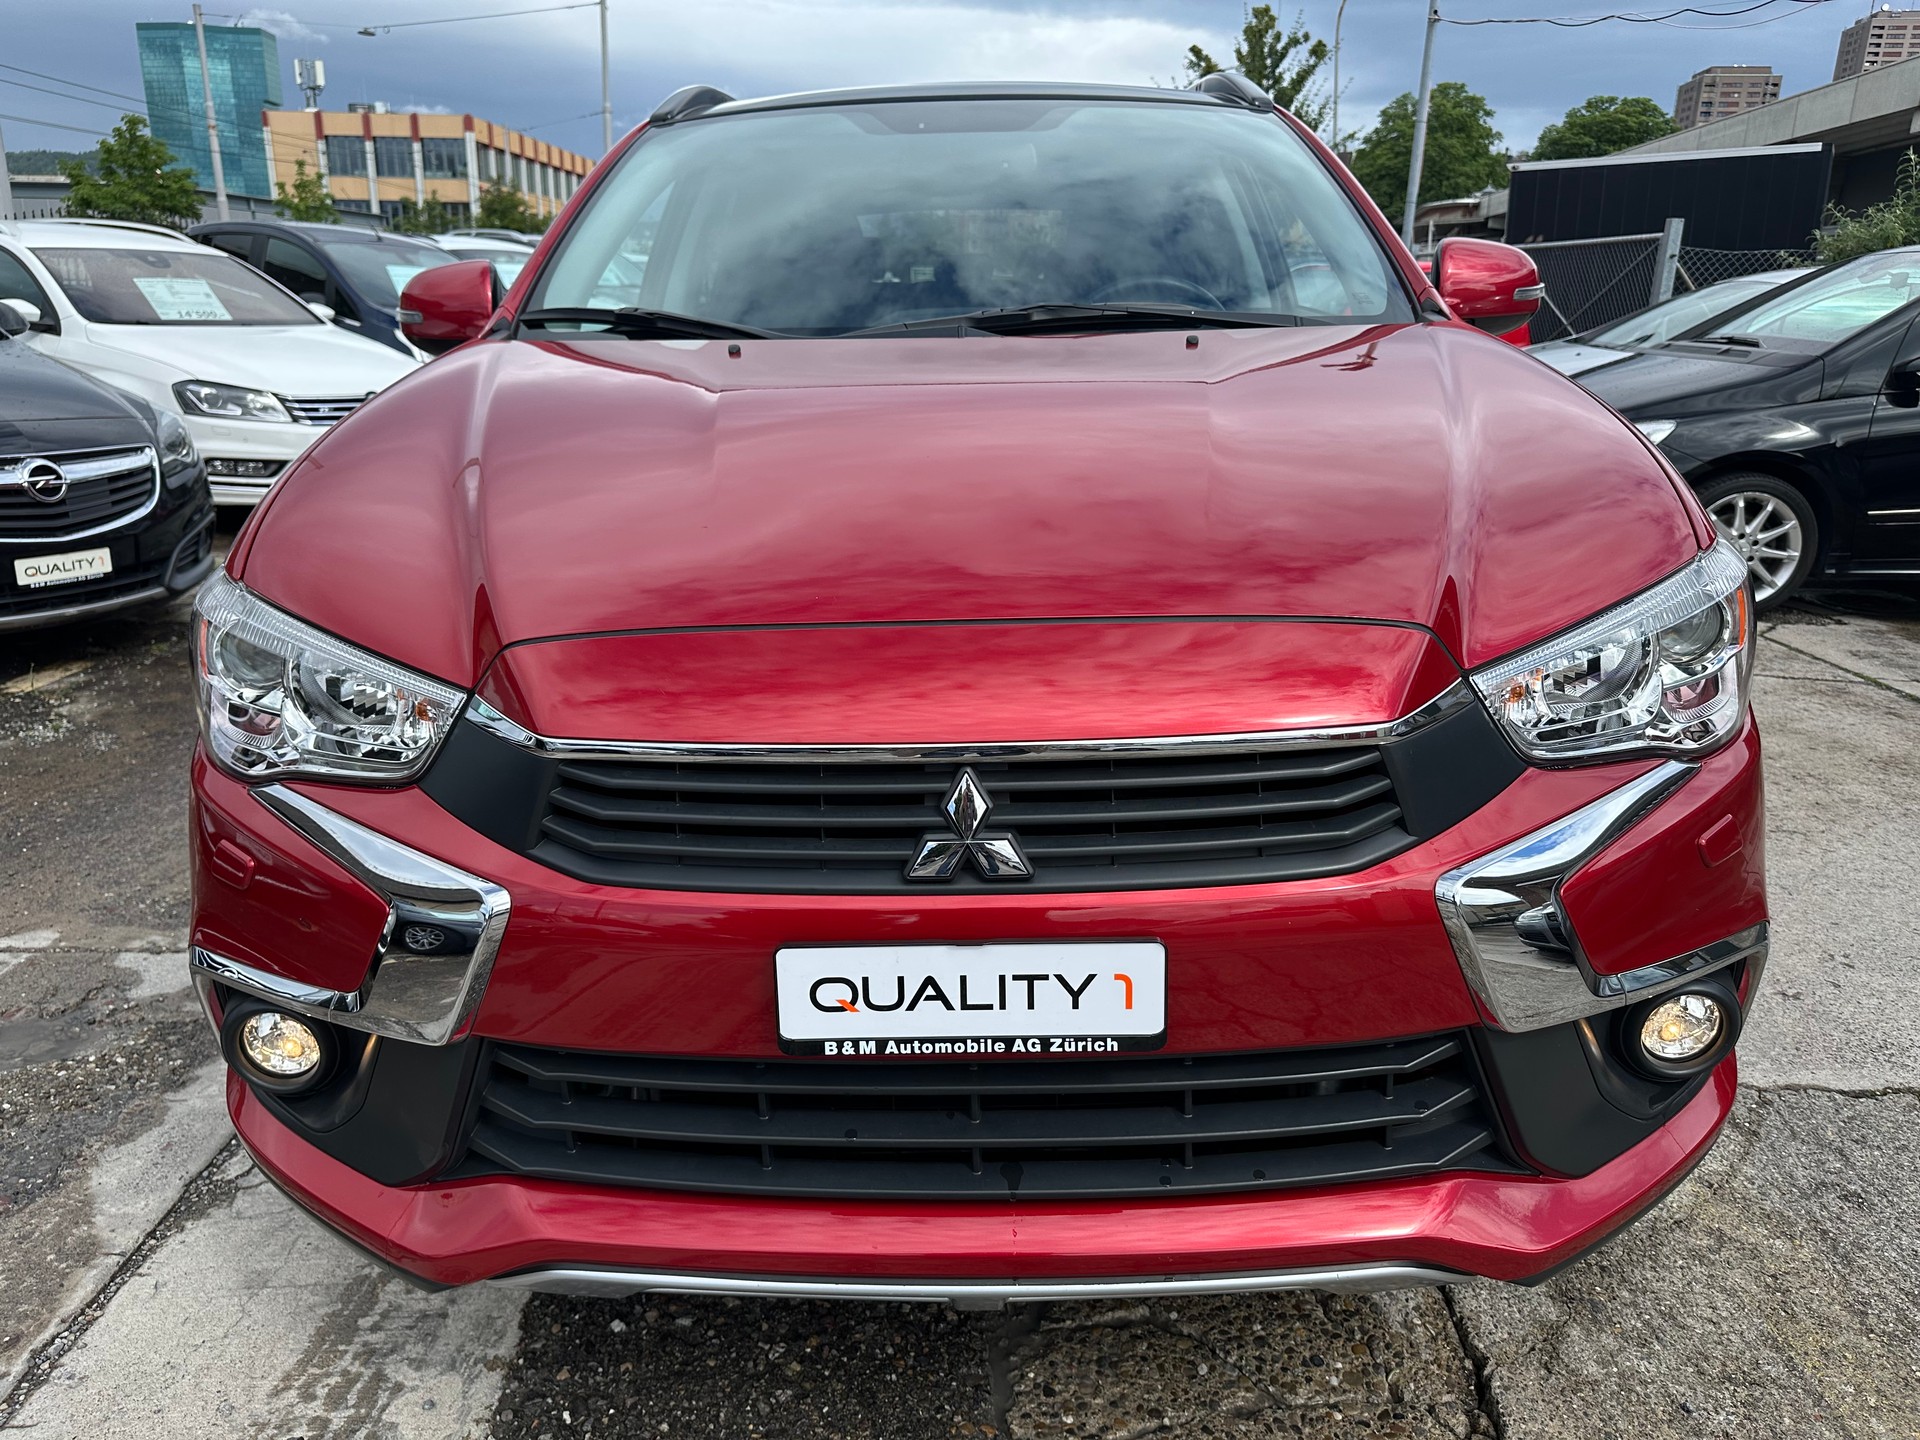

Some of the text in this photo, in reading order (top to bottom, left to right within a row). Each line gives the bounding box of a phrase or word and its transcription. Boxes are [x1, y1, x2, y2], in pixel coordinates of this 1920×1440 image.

[25, 557, 95, 577] QUALITY
[809, 973, 1133, 1013] QUALITY 1
[884, 1039, 1005, 1054] Automobile
[1012, 1038, 1041, 1053] AG
[1049, 1036, 1119, 1052] Zürich
